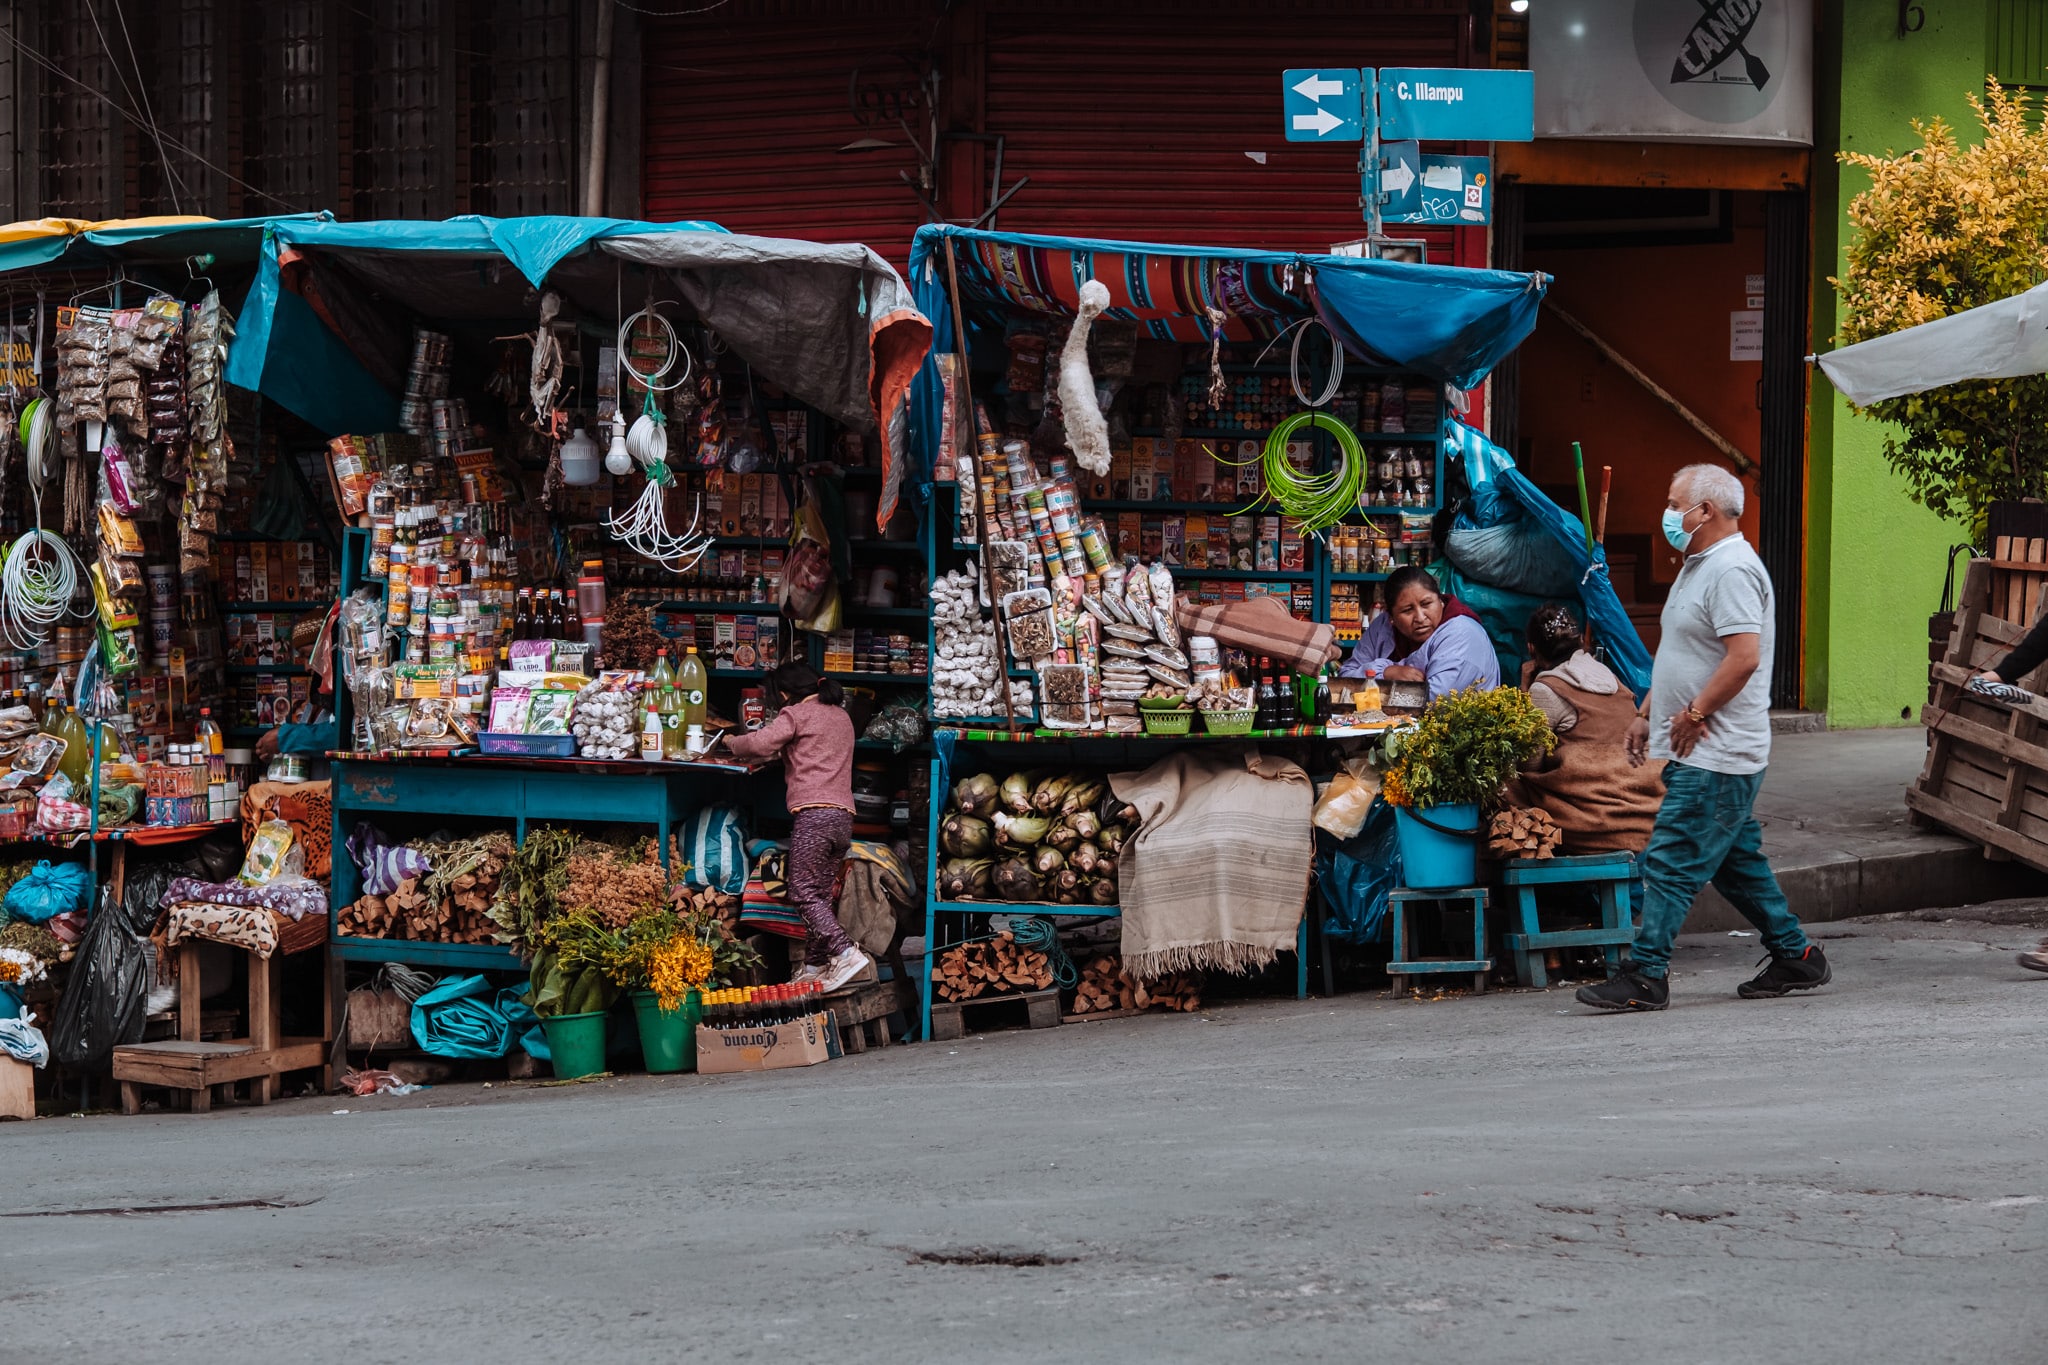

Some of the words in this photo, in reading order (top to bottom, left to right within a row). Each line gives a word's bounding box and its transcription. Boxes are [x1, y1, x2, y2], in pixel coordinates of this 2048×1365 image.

[1679, 0, 1759, 75] CANO
[1397, 81, 1413, 101] C.
[1415, 82, 1464, 105] Illampu
[519, 663, 539, 671] CARDO
[556, 663, 581, 672] ASHUA
[724, 1029, 778, 1057] Corona
